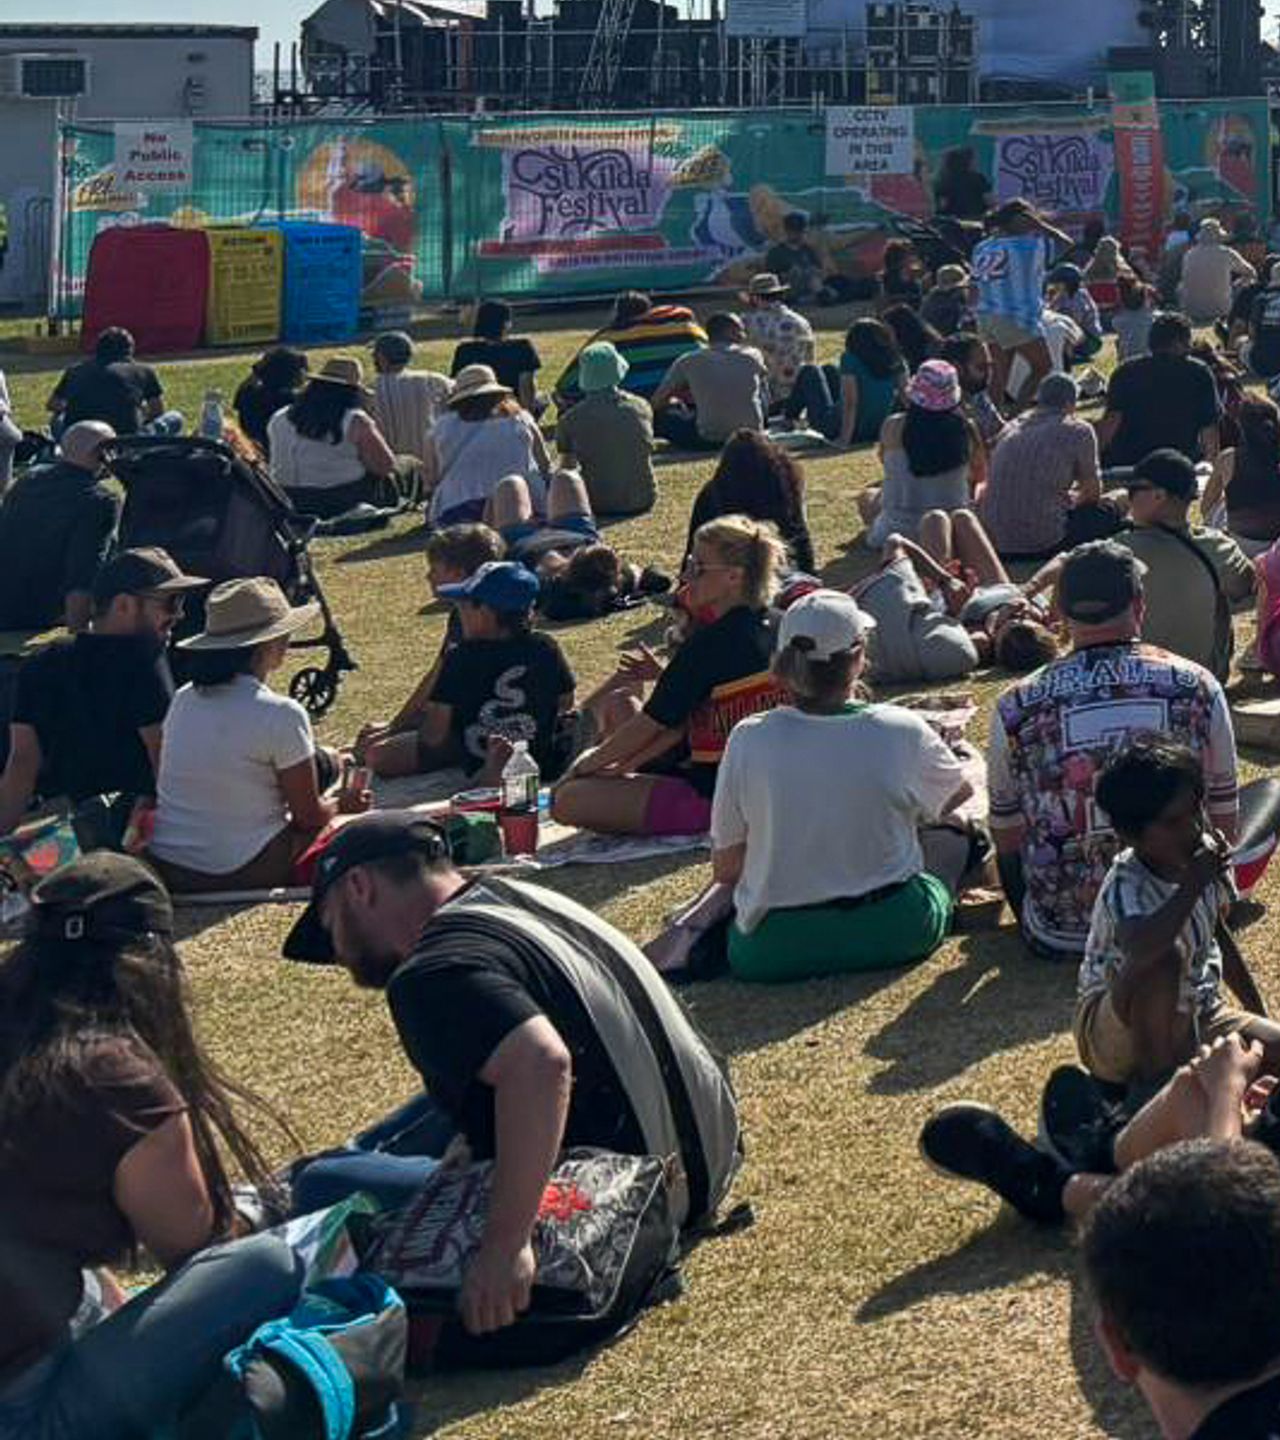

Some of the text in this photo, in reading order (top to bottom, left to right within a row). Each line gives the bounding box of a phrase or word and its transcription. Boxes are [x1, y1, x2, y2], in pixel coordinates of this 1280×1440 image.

[853, 110, 888, 122] CCTV
[144, 132, 168, 143] No
[833, 127, 908, 139] OPERATING
[129, 147, 182, 161] Public
[123, 169, 186, 182] Access
[577, 150, 650, 191] Kilda
[538, 185, 648, 234] Festival
